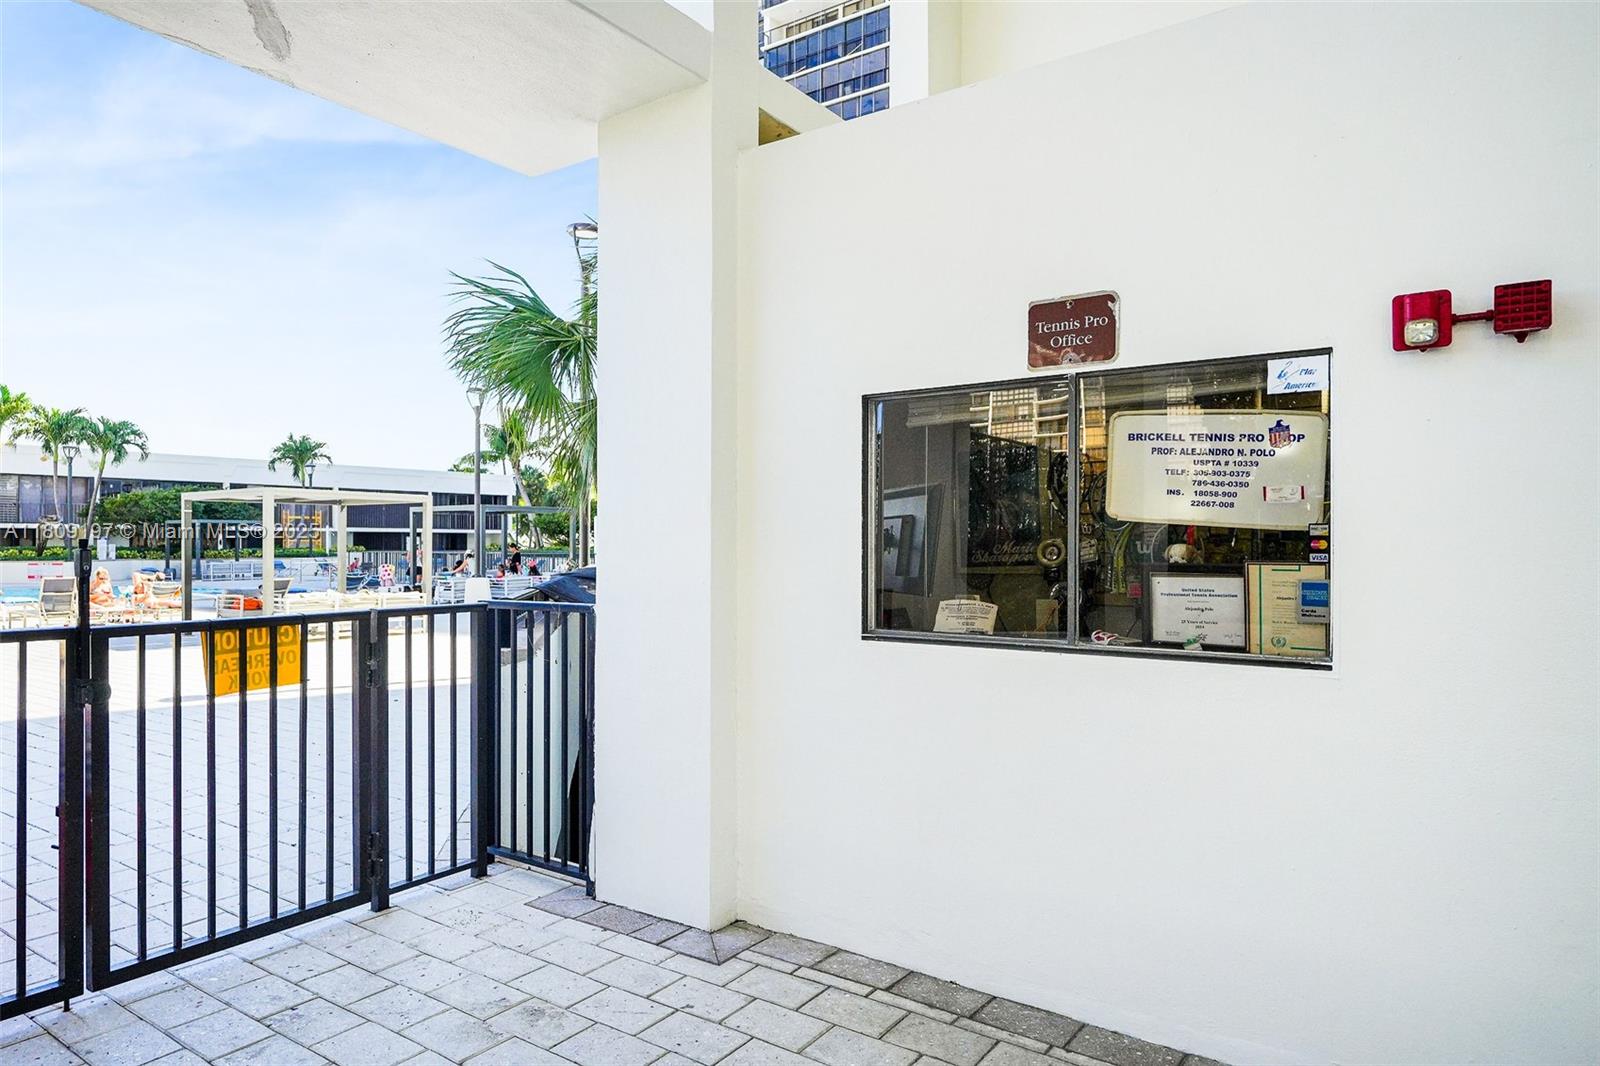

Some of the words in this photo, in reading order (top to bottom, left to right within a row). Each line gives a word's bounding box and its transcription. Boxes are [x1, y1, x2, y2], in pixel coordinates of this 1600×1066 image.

[1035, 318, 1080, 334] Tennis
[1084, 315, 1109, 328] Pro
[1050, 334, 1093, 348] Office
[1127, 432, 1186, 442] BRICKELL
[1189, 433, 1236, 443] TENNIS
[1239, 433, 1265, 443] PRO
[1151, 446, 1178, 456] PROF:
[1179, 447, 1235, 457] ALEJANDRO
[1237, 448, 1247, 457] N.
[1250, 448, 1276, 457] POLO
[1192, 459, 1222, 467] USPTA
[1232, 460, 1259, 468] 10339
[1165, 468, 1190, 476] TELF:
[1192, 480, 1250, 488] 786-436-0350
[1166, 488, 1185, 496] INS.
[1193, 490, 1238, 498] 18058-900
[1190, 500, 1235, 509] 22667-008
